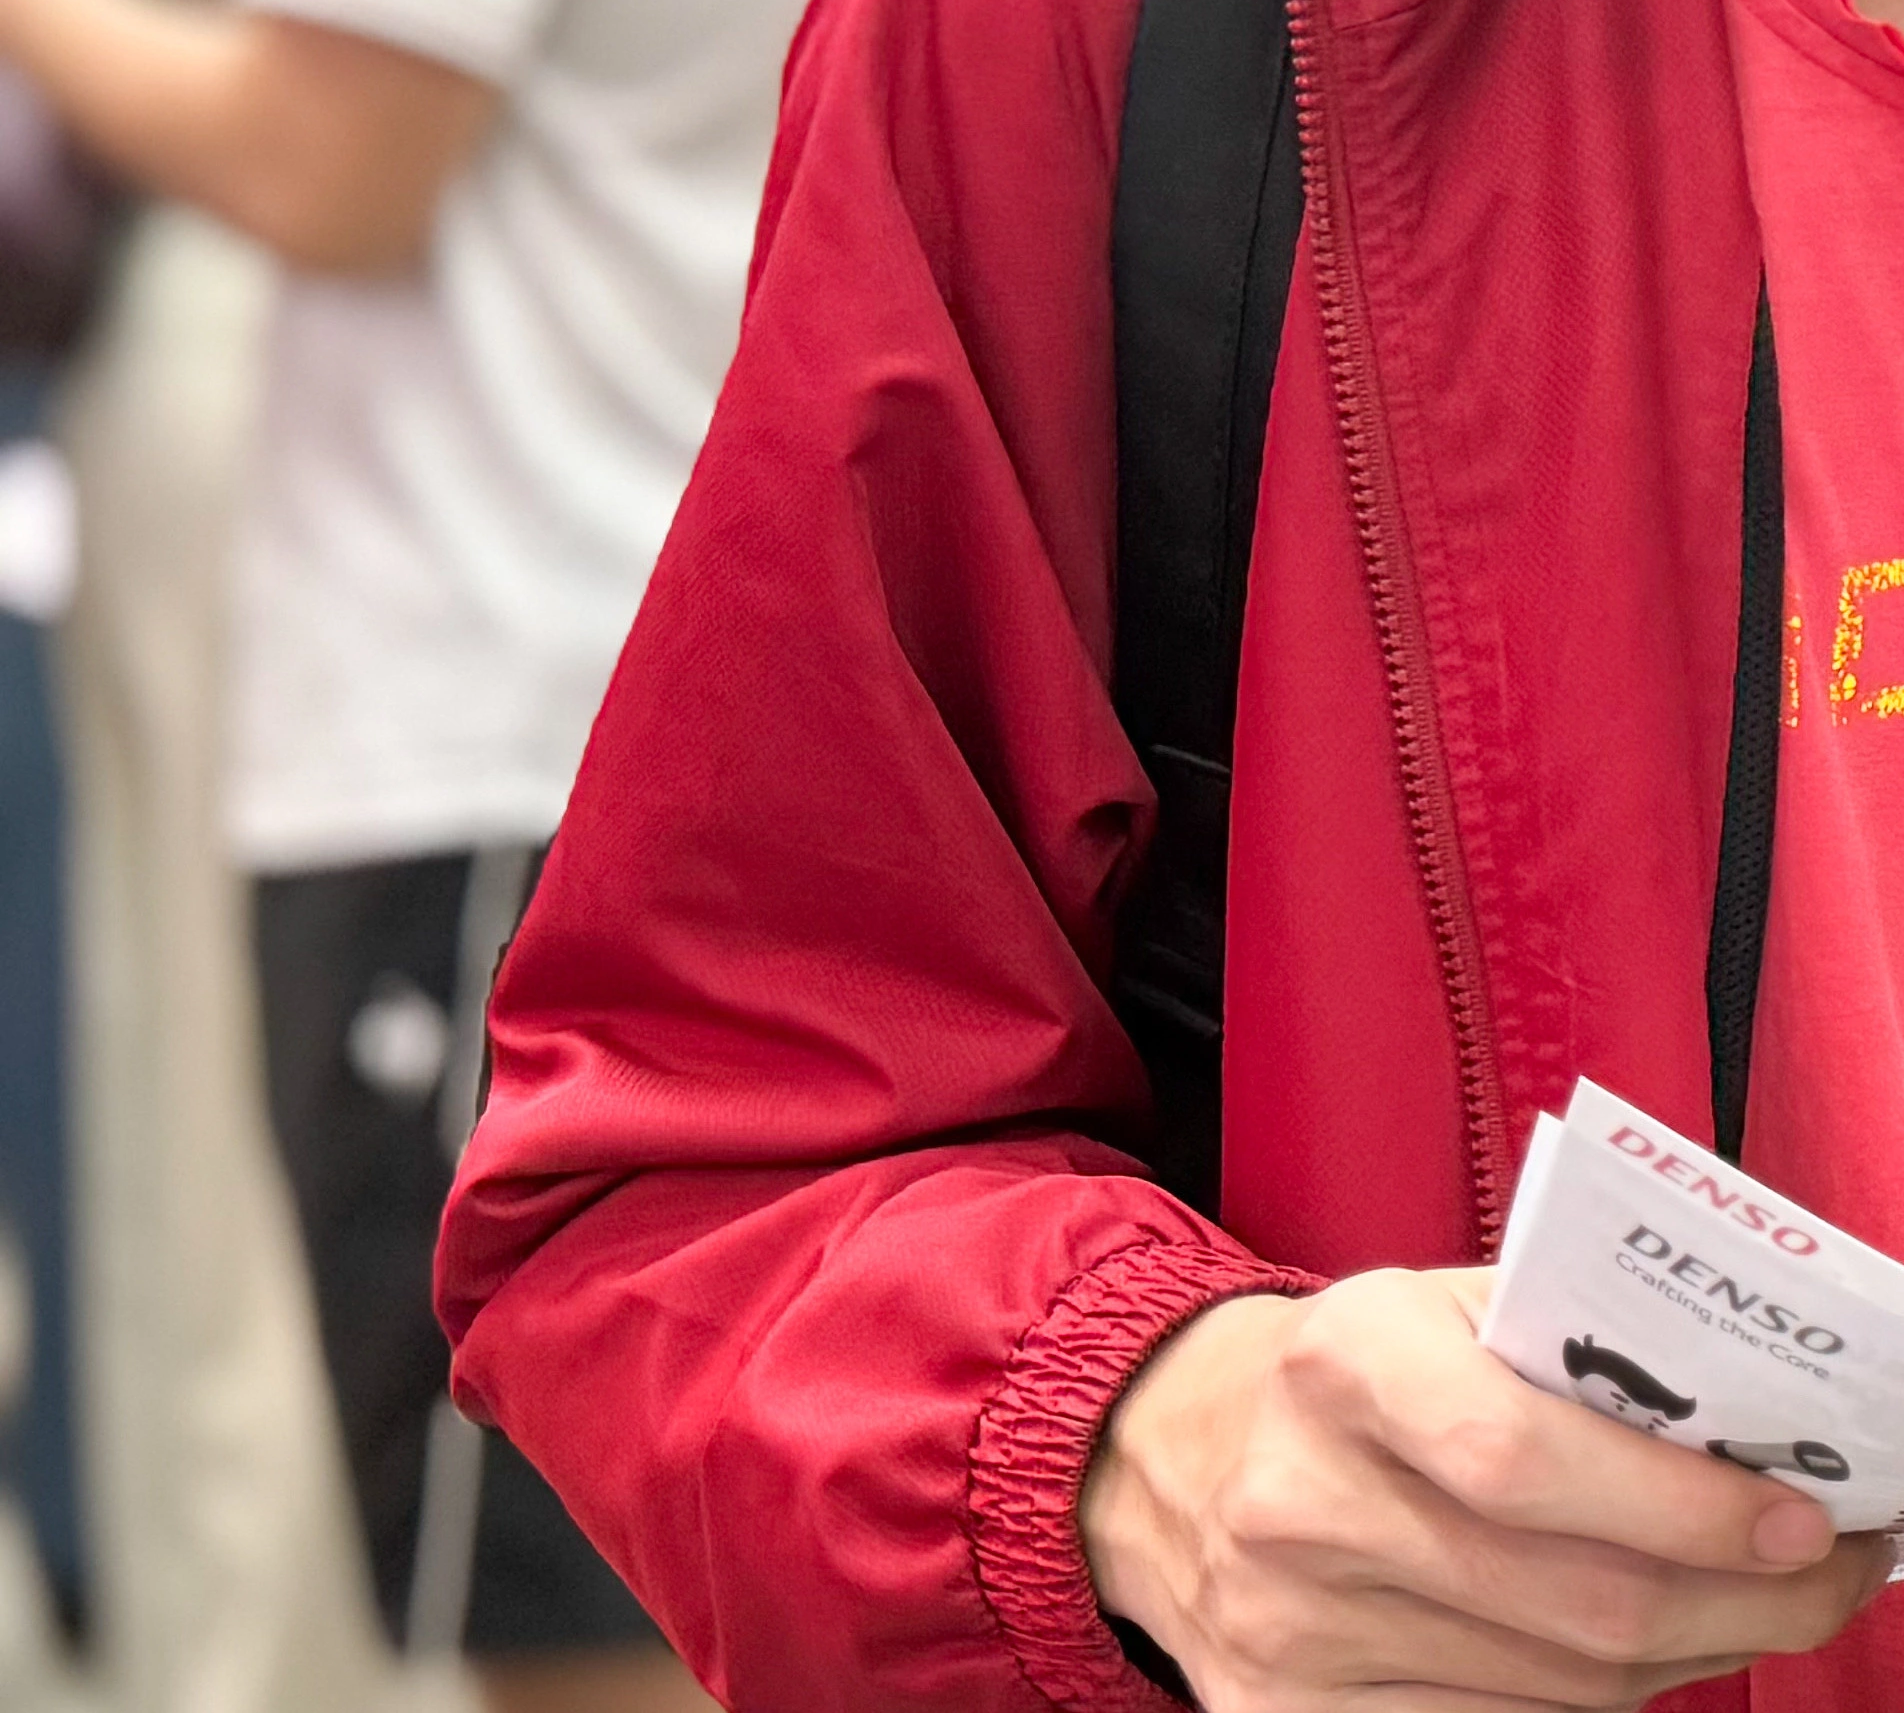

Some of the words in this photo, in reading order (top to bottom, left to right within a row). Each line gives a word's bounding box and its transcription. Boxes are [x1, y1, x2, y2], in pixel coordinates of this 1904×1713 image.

[1607, 1125, 1820, 1256] DENSO
[1615, 1251, 1713, 1327] Crafting
[1719, 1315, 1762, 1349] the
[1768, 1341, 1832, 1381] Core
[1622, 1224, 1846, 1355] DENSO
